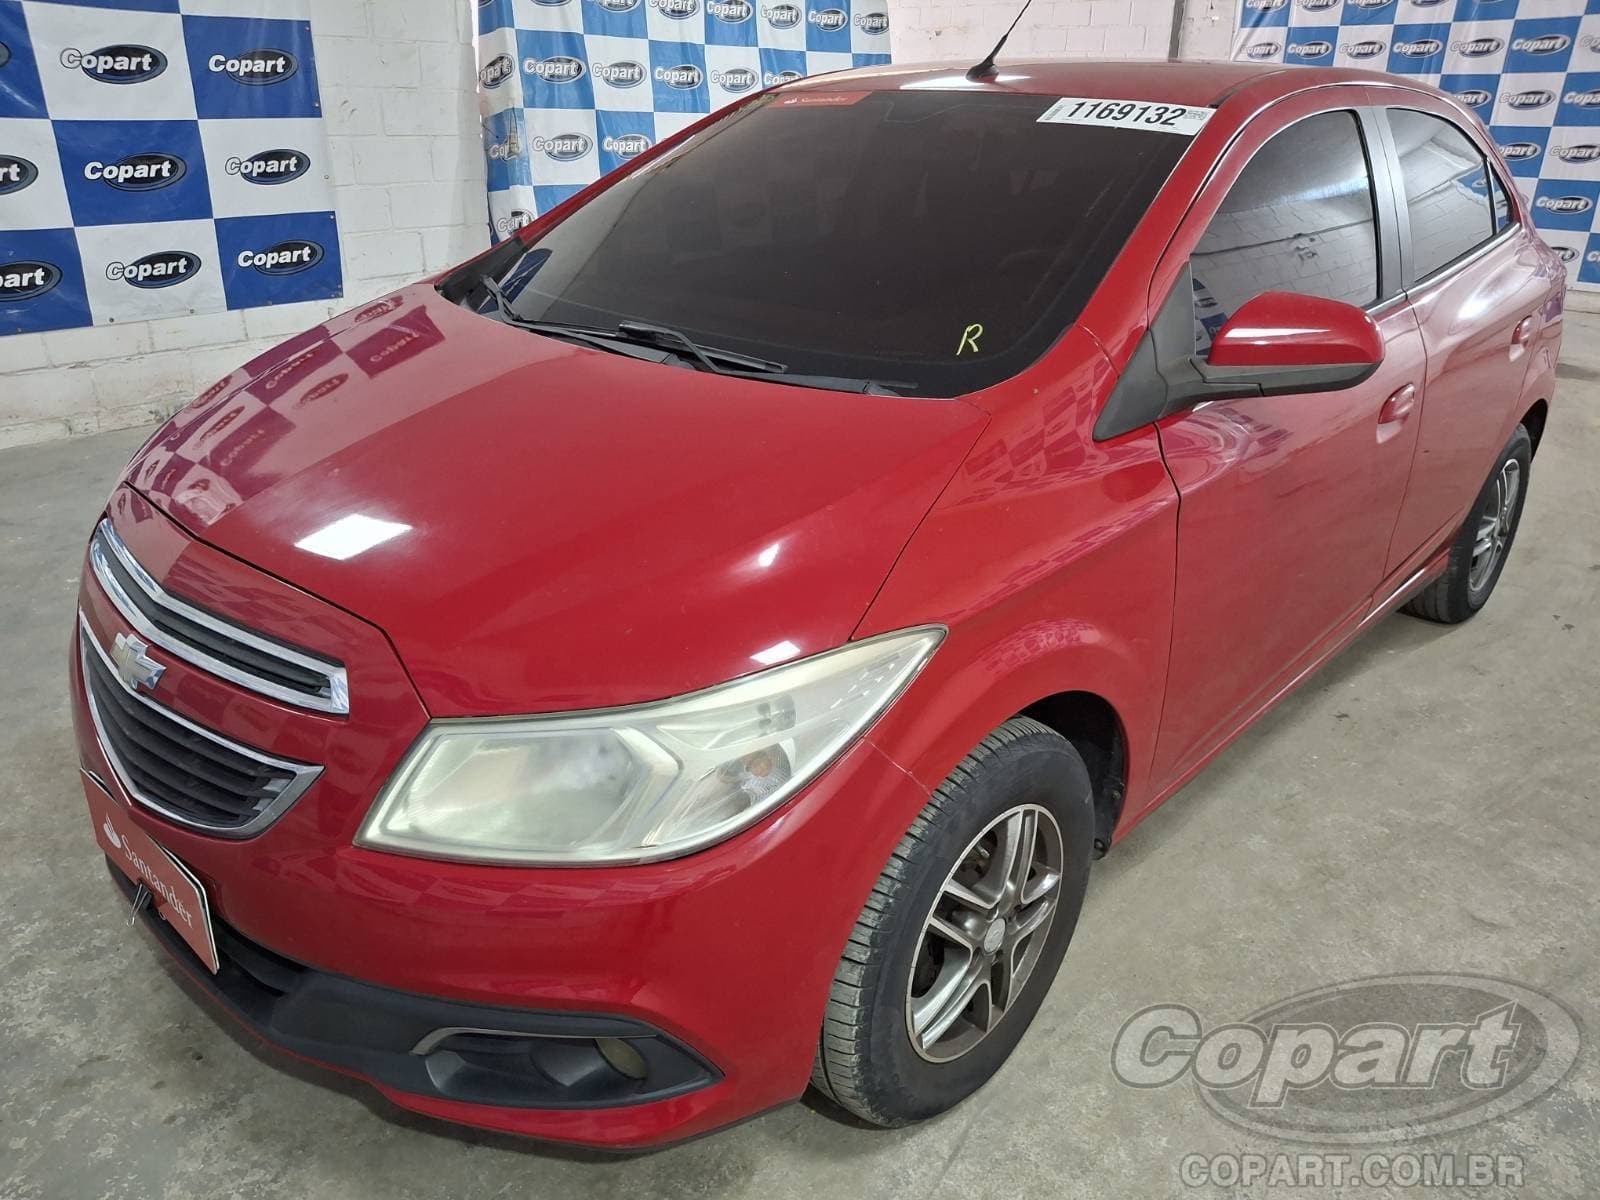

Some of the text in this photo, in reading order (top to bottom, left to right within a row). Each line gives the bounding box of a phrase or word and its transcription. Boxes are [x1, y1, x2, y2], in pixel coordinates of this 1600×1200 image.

[706, 0, 748, 17] Copart
[761, 8, 798, 23] Copart
[807, 10, 844, 25] Copart
[854, 14, 888, 28] Copart
[1287, 42, 1330, 56] Copart
[1339, 42, 1384, 56] Copart
[1393, 41, 1437, 54] Copart
[1451, 39, 1498, 54] Copart
[1511, 38, 1564, 52] Copart
[60, 47, 152, 73] Copart
[208, 54, 286, 76] Copart
[524, 58, 578, 77] Copart
[592, 63, 641, 82] Copart
[655, 68, 698, 85] Copart
[711, 70, 755, 87] Copart
[1500, 91, 1549, 107] Copart
[1563, 91, 1600, 106] Copa
[1067, 101, 1187, 126] 1169132
[532, 136, 586, 155] Copart
[604, 137, 647, 153] Copart
[1551, 146, 1600, 160] Copart
[84, 161, 172, 183] Copart
[225, 155, 298, 181] Copart
[1536, 197, 1587, 210] Copart
[237, 246, 312, 269] Copart
[105, 257, 188, 282] Copart
[956, 323, 984, 356] R
[120, 834, 194, 929] Santander
